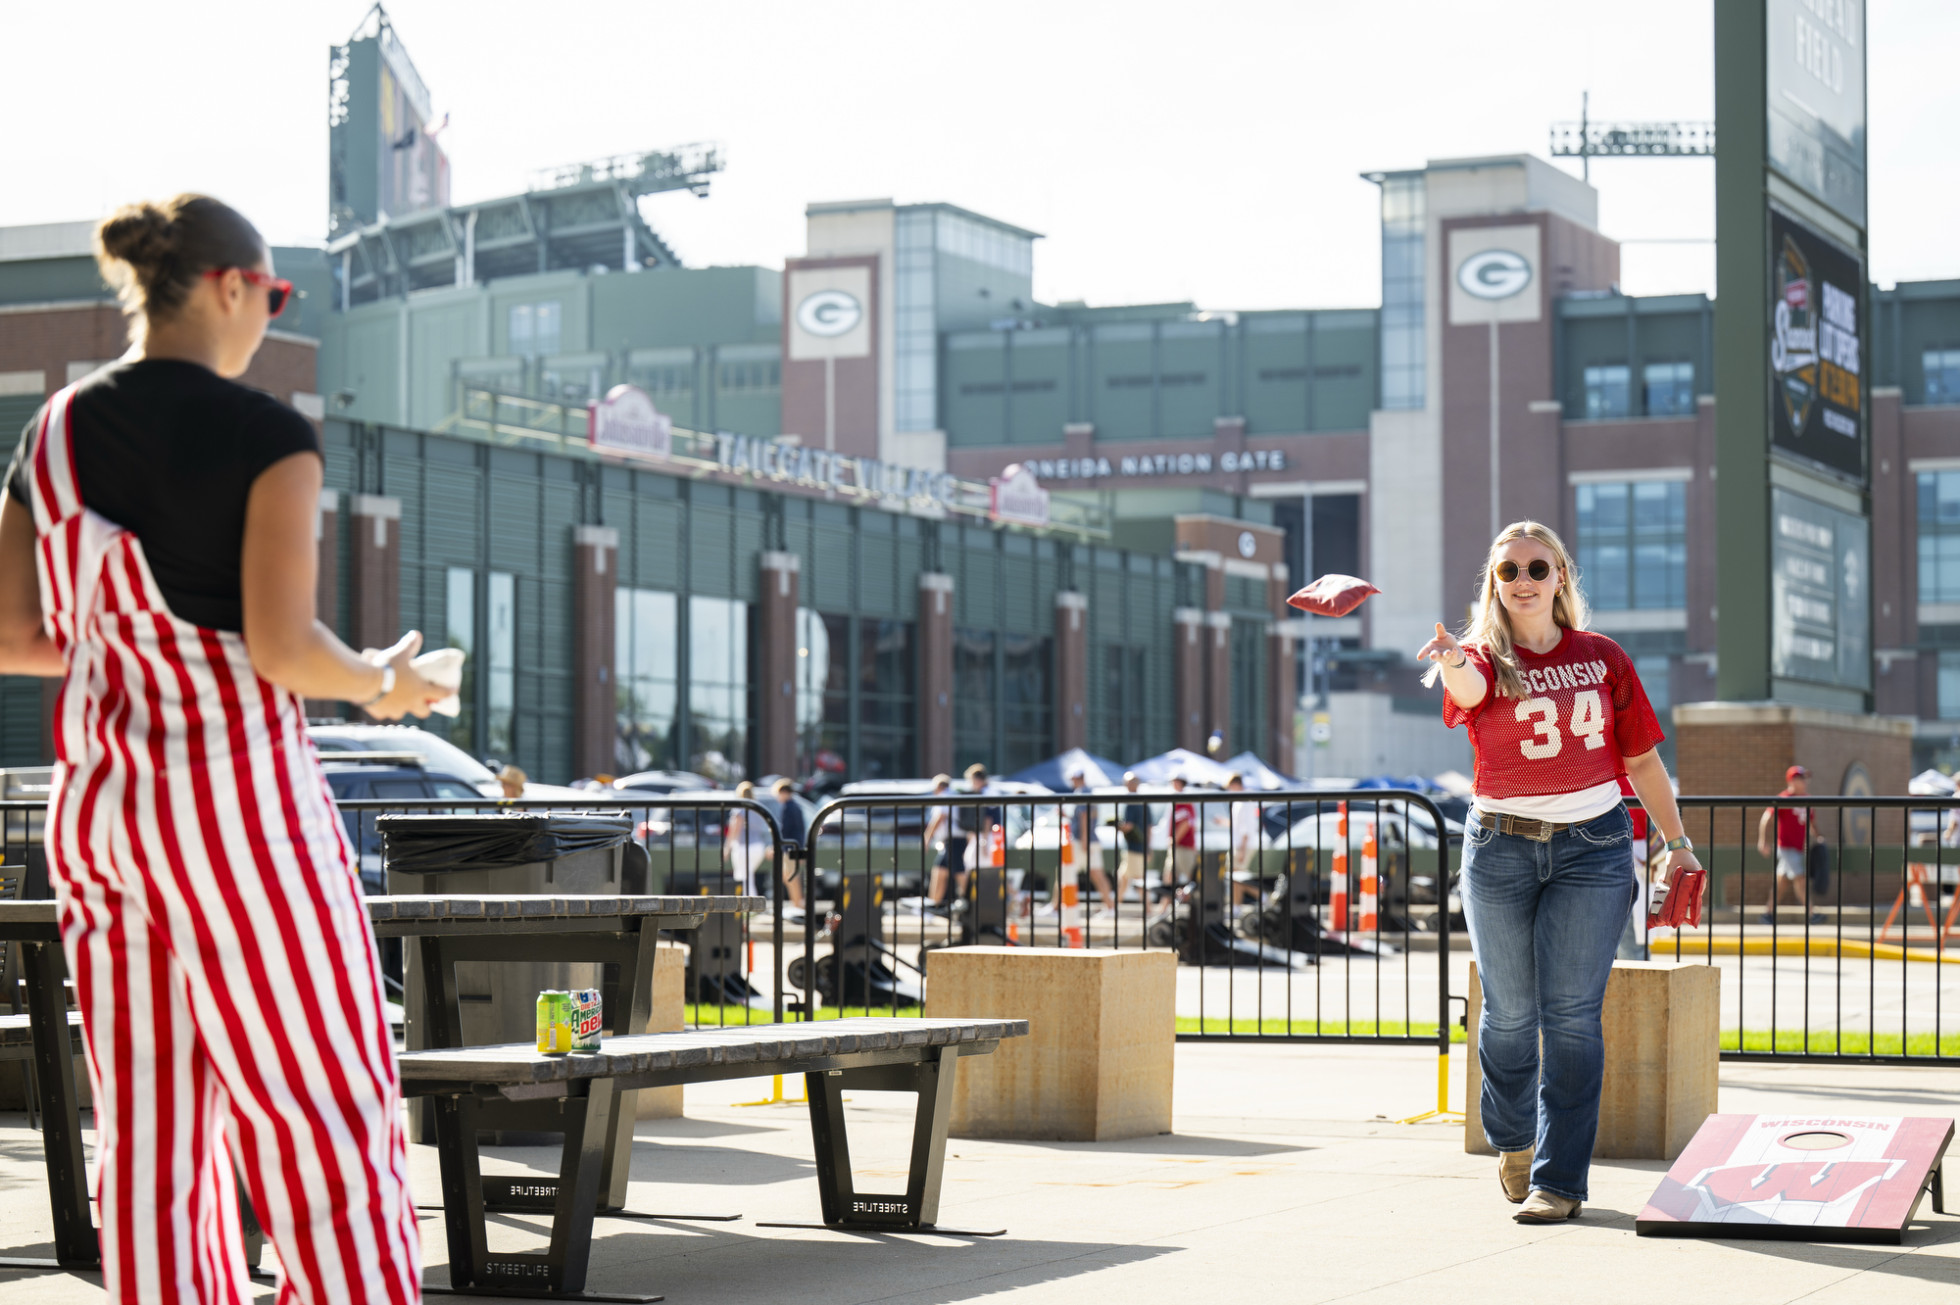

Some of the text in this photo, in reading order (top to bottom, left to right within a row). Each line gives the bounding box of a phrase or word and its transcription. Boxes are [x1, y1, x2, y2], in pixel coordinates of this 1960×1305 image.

[1794, 15, 1843, 95] FIELD
[1459, 249, 1531, 299] G
[797, 290, 862, 336] G
[716, 431, 845, 487] TAILGATE
[853, 456, 957, 503] VILLAGE
[1121, 453, 1213, 476] NATION
[1220, 450, 1285, 474] GATE
[1494, 659, 1608, 698] SCONSIN
[1514, 689, 1607, 760] 34
[1761, 1119, 1890, 1131] WISCONSIN
[486, 1262, 549, 1277] STREETLIFE
